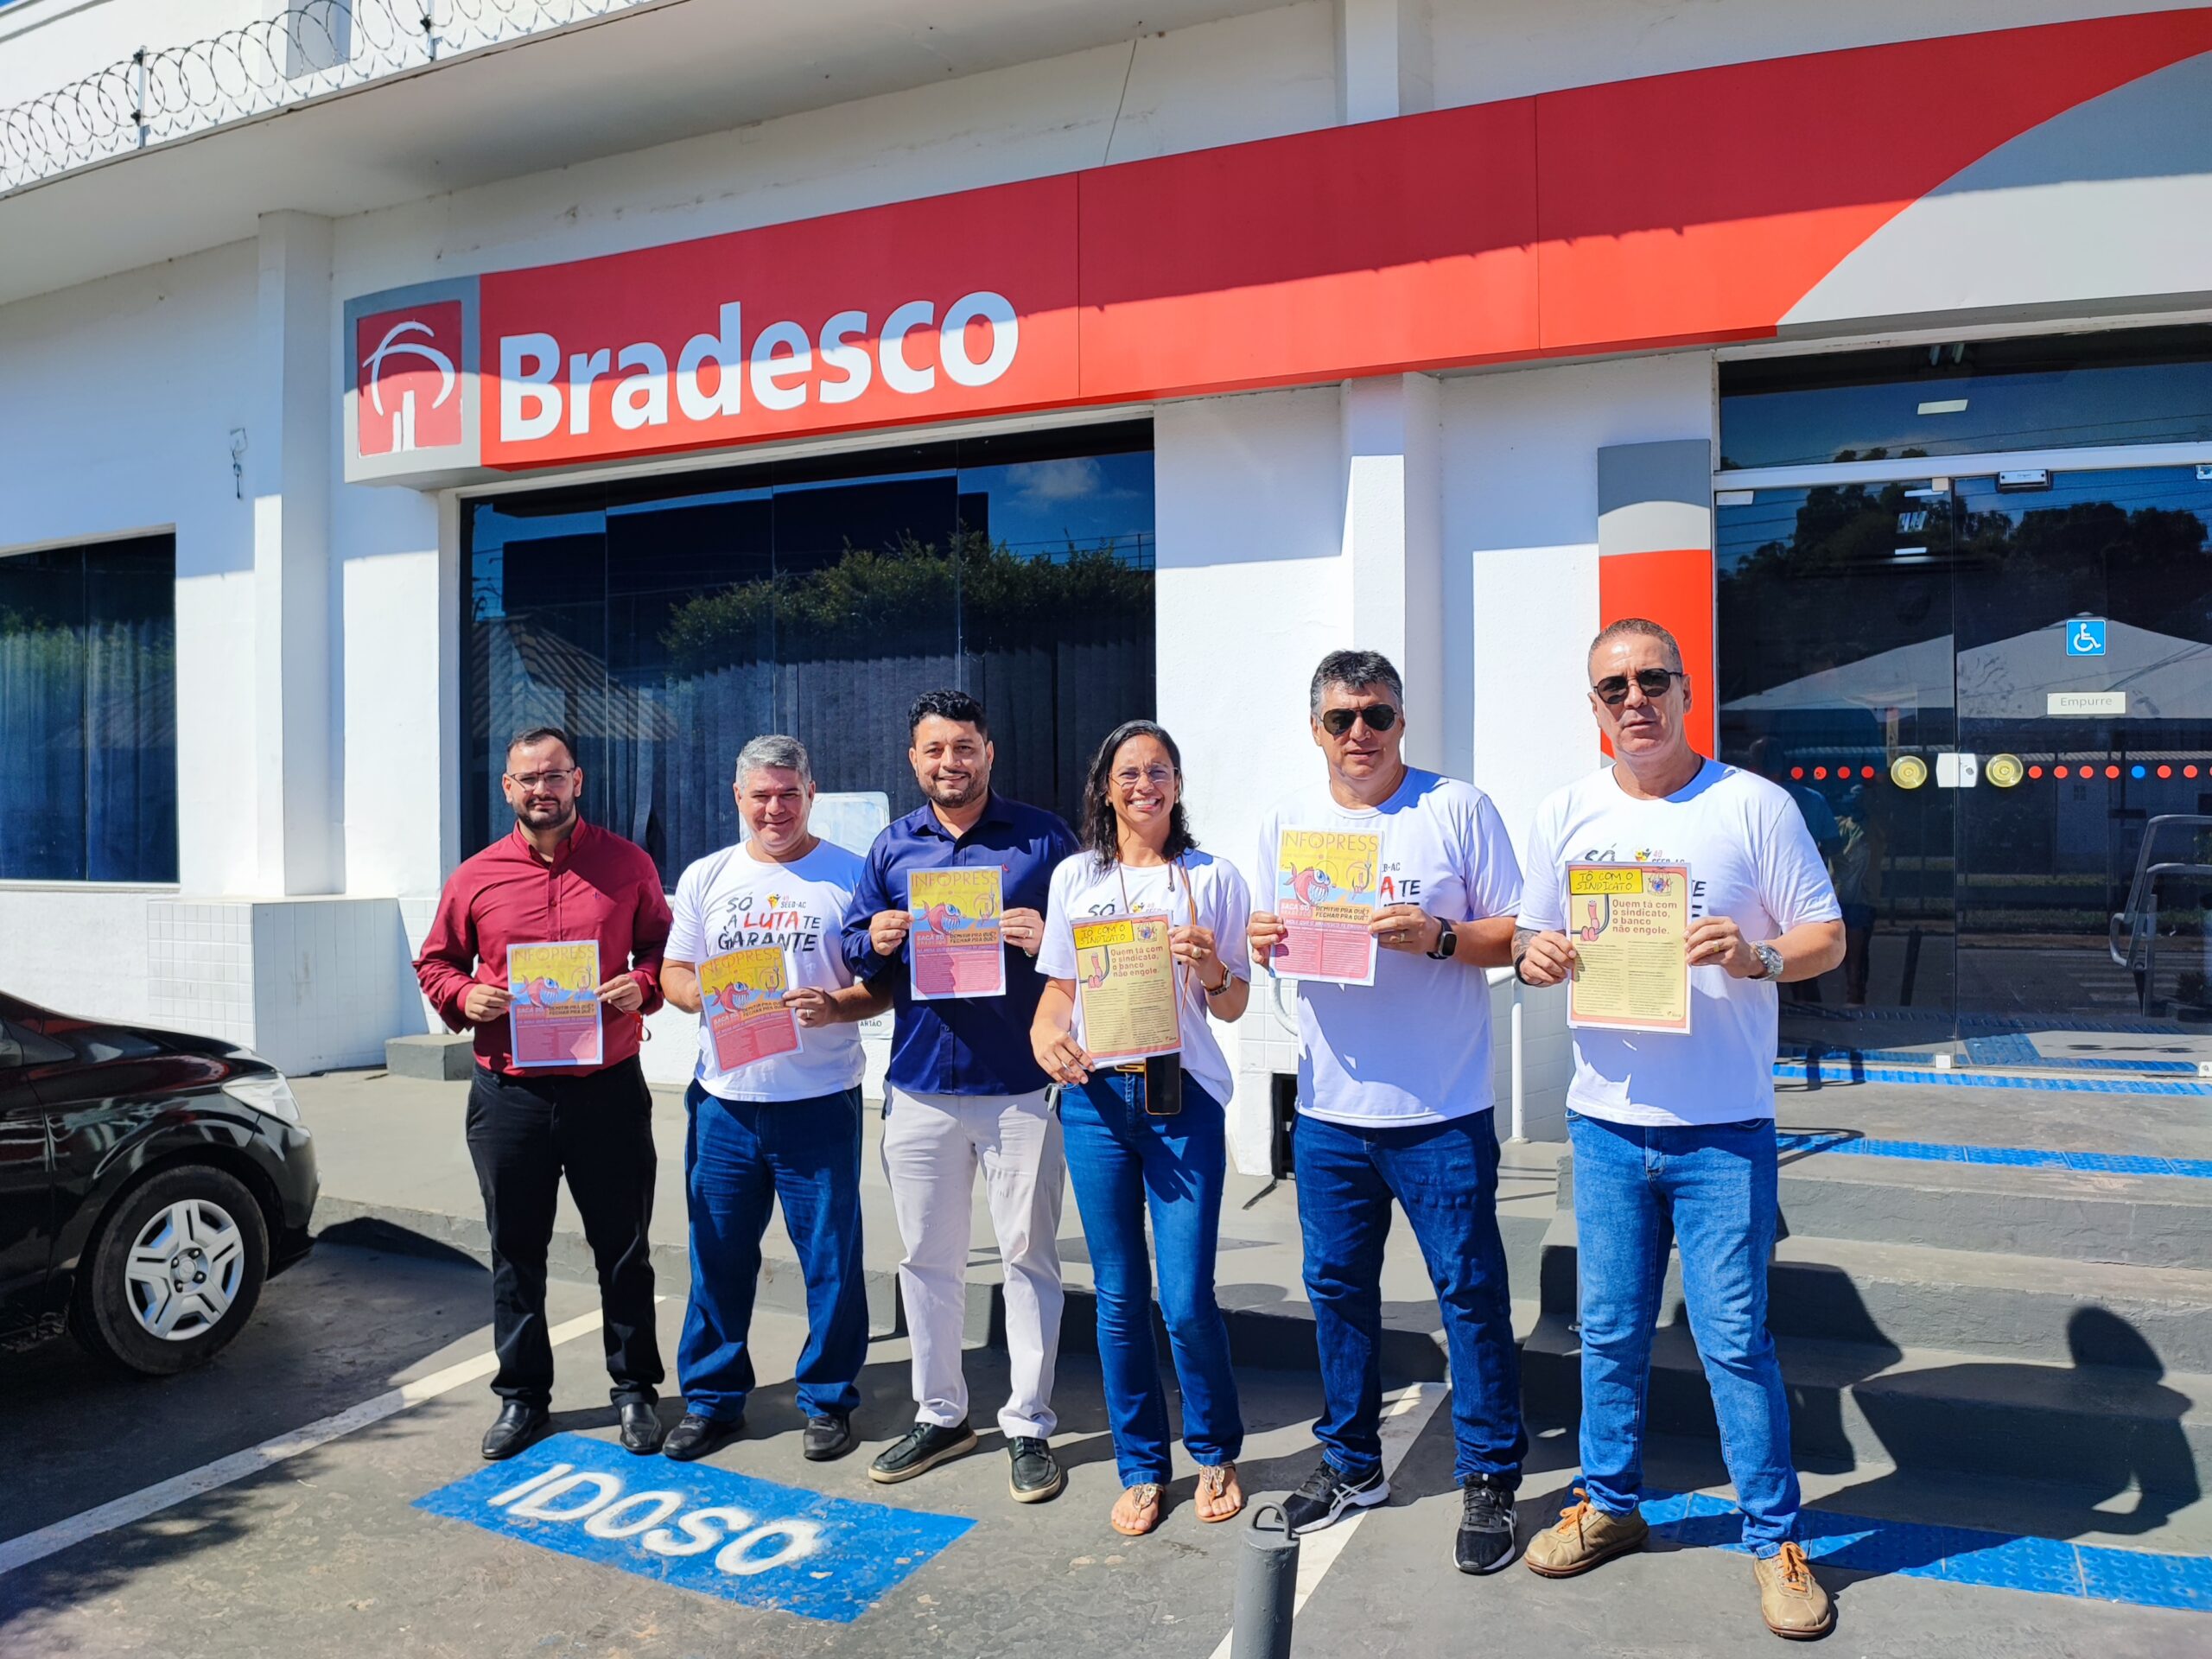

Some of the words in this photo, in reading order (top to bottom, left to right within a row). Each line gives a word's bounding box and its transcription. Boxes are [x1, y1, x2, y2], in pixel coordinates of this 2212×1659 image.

[499, 290, 1020, 442] Bradesco
[2060, 697, 2113, 709] Empurre
[1281, 830, 1379, 852] INFOPRESS
[912, 872, 1000, 887] INFOPRESS
[1580, 870, 1593, 881] TÔ
[1599, 872, 1622, 881] COM
[1626, 872, 1634, 880] O
[1398, 880, 1421, 898] TE
[1576, 881, 1632, 891] SINDICATO
[726, 892, 753, 913] SÓ
[1612, 899, 1643, 909] Quem
[1643, 899, 1653, 909] tá
[728, 913, 738, 929] A
[743, 911, 798, 931] LUTA
[803, 916, 822, 929] TE
[1621, 916, 1651, 925] banco
[1612, 925, 1629, 933] não
[1632, 925, 1670, 936] engole.
[718, 930, 818, 953] GARANTE
[511, 946, 596, 963] INFOPRESS
[860, 1019, 882, 1027] ARTÃO
[486, 1462, 826, 1576] IDOSO
